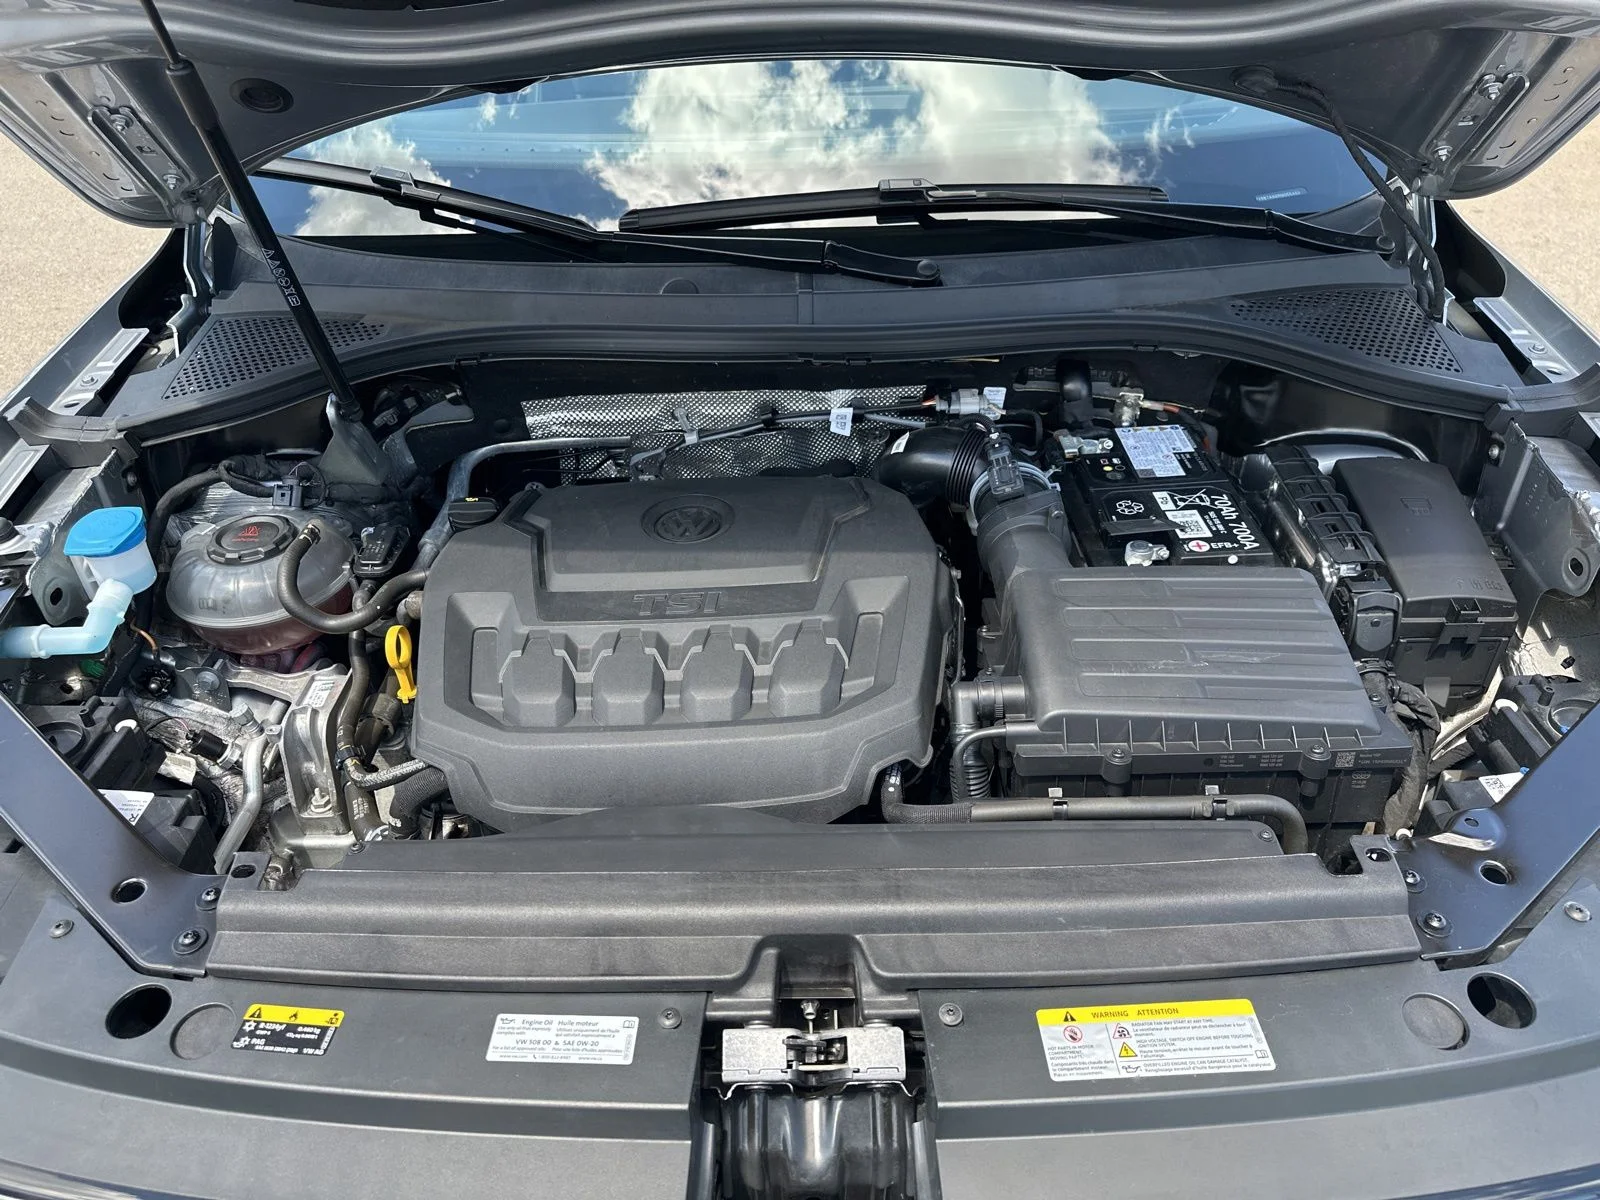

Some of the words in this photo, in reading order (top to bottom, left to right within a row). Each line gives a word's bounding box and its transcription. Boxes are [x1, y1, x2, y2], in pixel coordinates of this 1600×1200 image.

[1211, 494, 1239, 520] 70Ah
[1228, 522, 1260, 550] 700A
[632, 592, 722, 616] TSI
[1092, 1010, 1129, 1019] WARNING
[1137, 1008, 1179, 1016] ATTENTION
